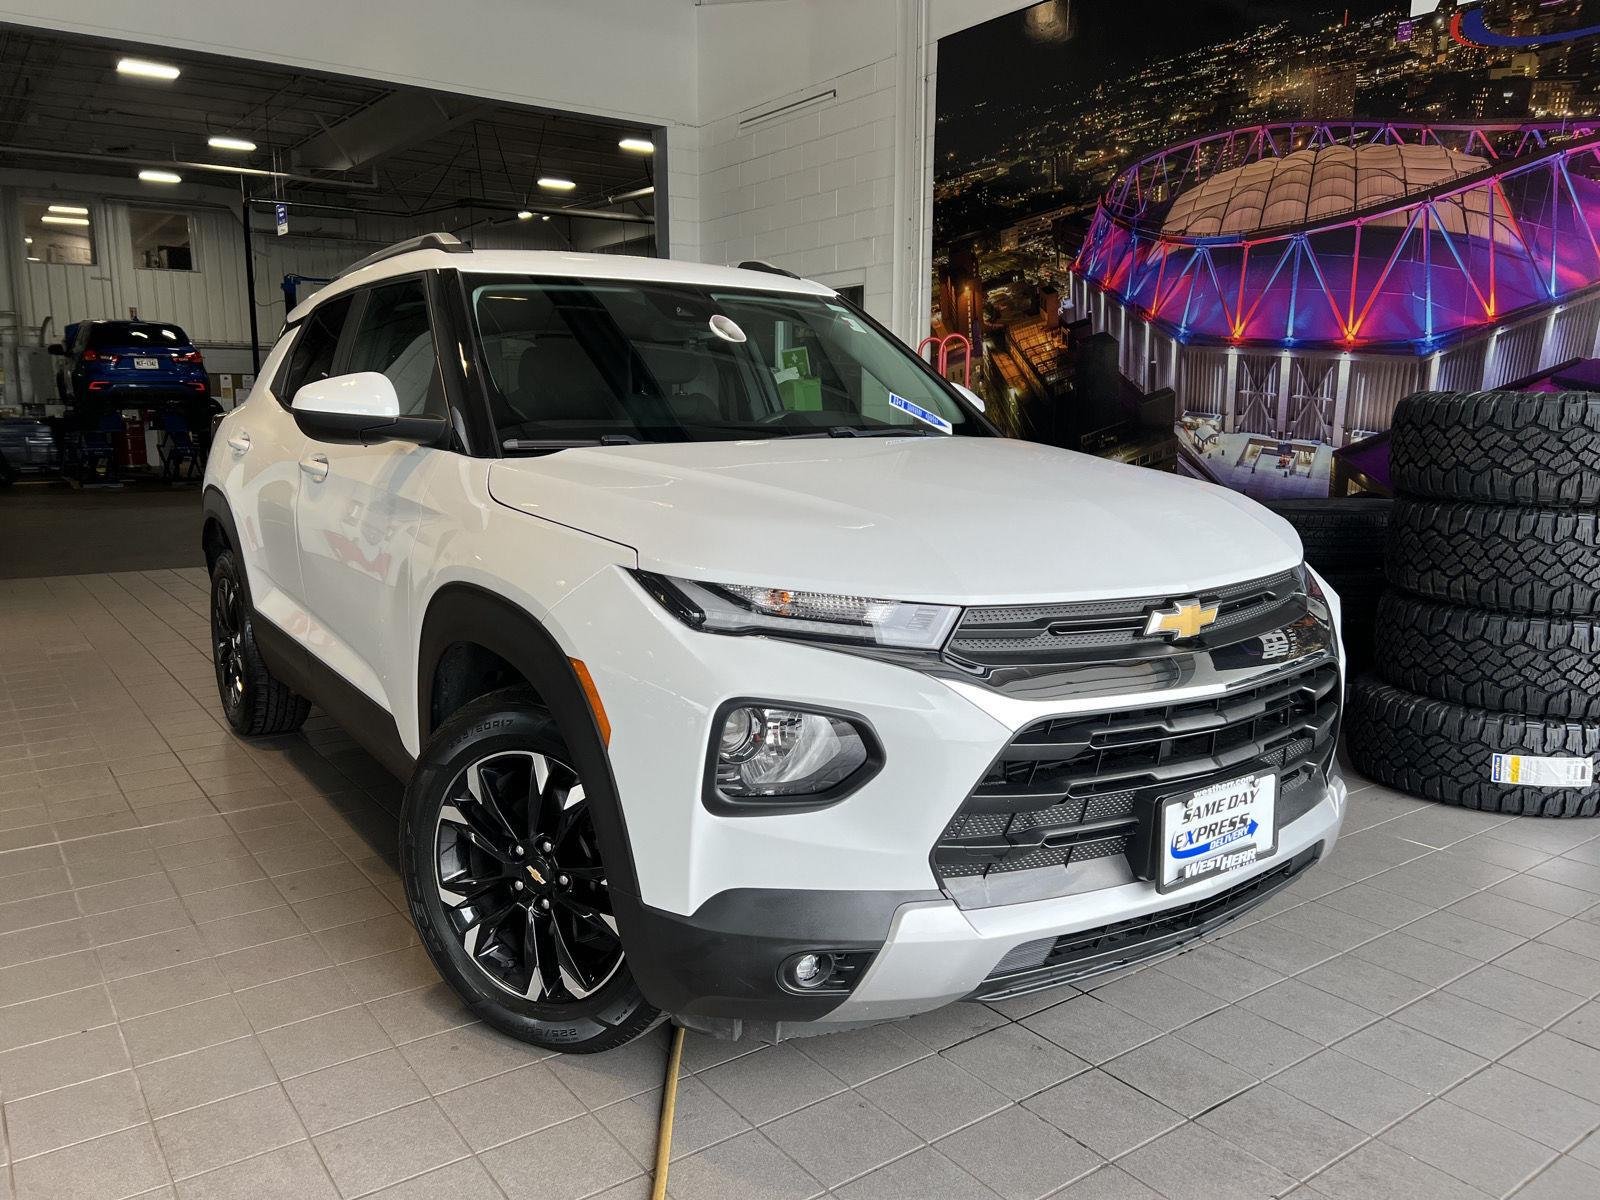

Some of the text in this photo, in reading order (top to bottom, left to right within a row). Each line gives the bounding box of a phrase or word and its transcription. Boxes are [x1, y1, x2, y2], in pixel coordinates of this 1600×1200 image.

[1194, 775, 1255, 798] westherr.com
[1182, 788, 1260, 825] SAME DAY
[1174, 812, 1250, 850] EXPRESS
[1209, 824, 1250, 850] DELIVERY
